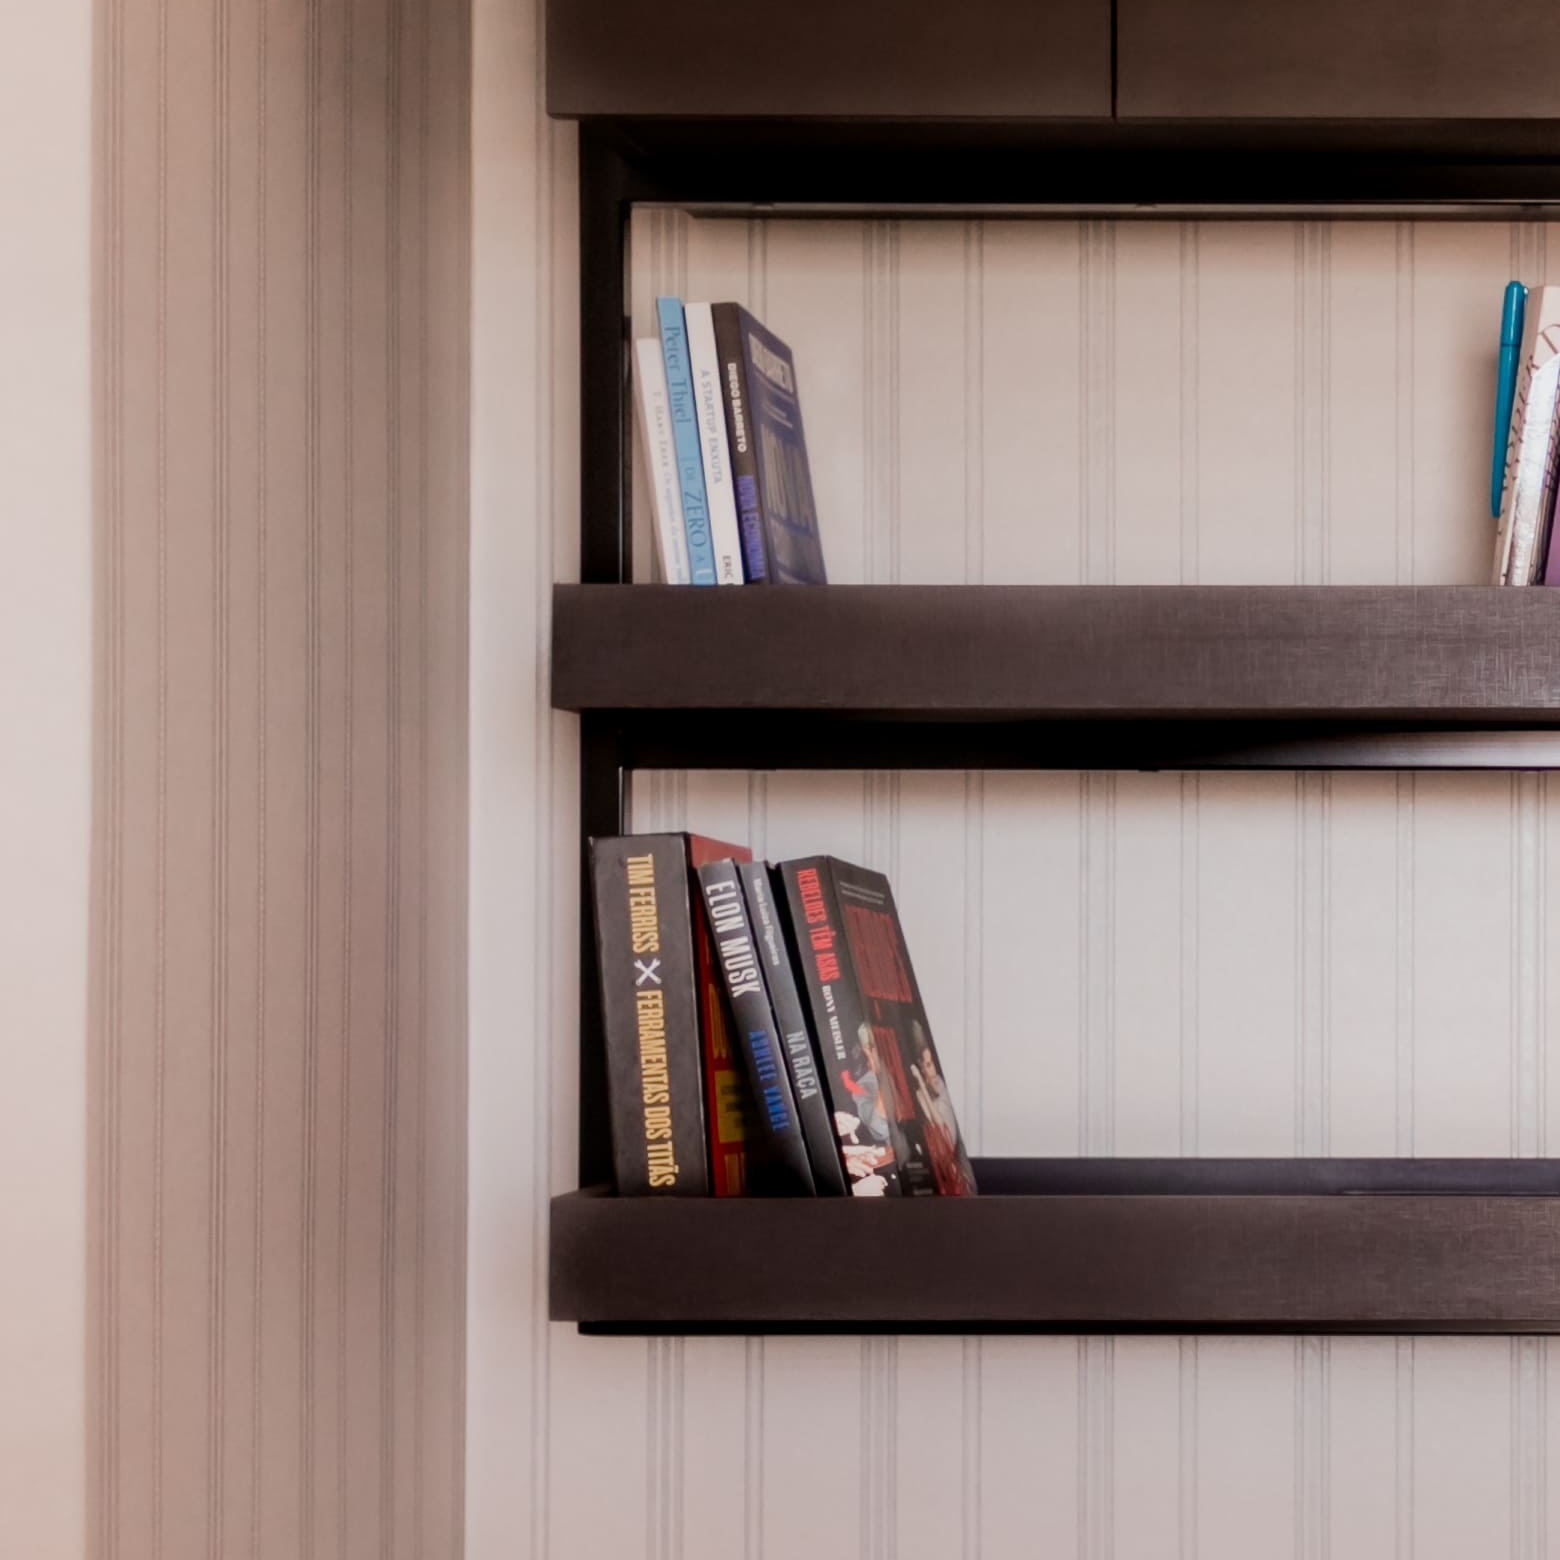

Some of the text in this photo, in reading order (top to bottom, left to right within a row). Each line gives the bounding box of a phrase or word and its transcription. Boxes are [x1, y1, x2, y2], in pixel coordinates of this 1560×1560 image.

[664, 326, 692, 423] Peter Thiel
[727, 362, 748, 453] DIEGO BARRETO
[701, 370, 723, 485] A STARTUP ENXUTA
[684, 489, 708, 548] ZERO
[722, 555, 734, 579] ERIC
[706, 880, 745, 933] ELON
[797, 868, 841, 982] REBELDES TÊM ASAS
[720, 936, 761, 998] MUSK
[627, 853, 680, 1188] TIM FERRISS FERRAMENTAS DOS TITÃS
[822, 985, 847, 1061] RONY MEISLER
[750, 1030, 790, 1132] ASHLEE VANCE
[787, 1031, 818, 1101] NA RAÇA
